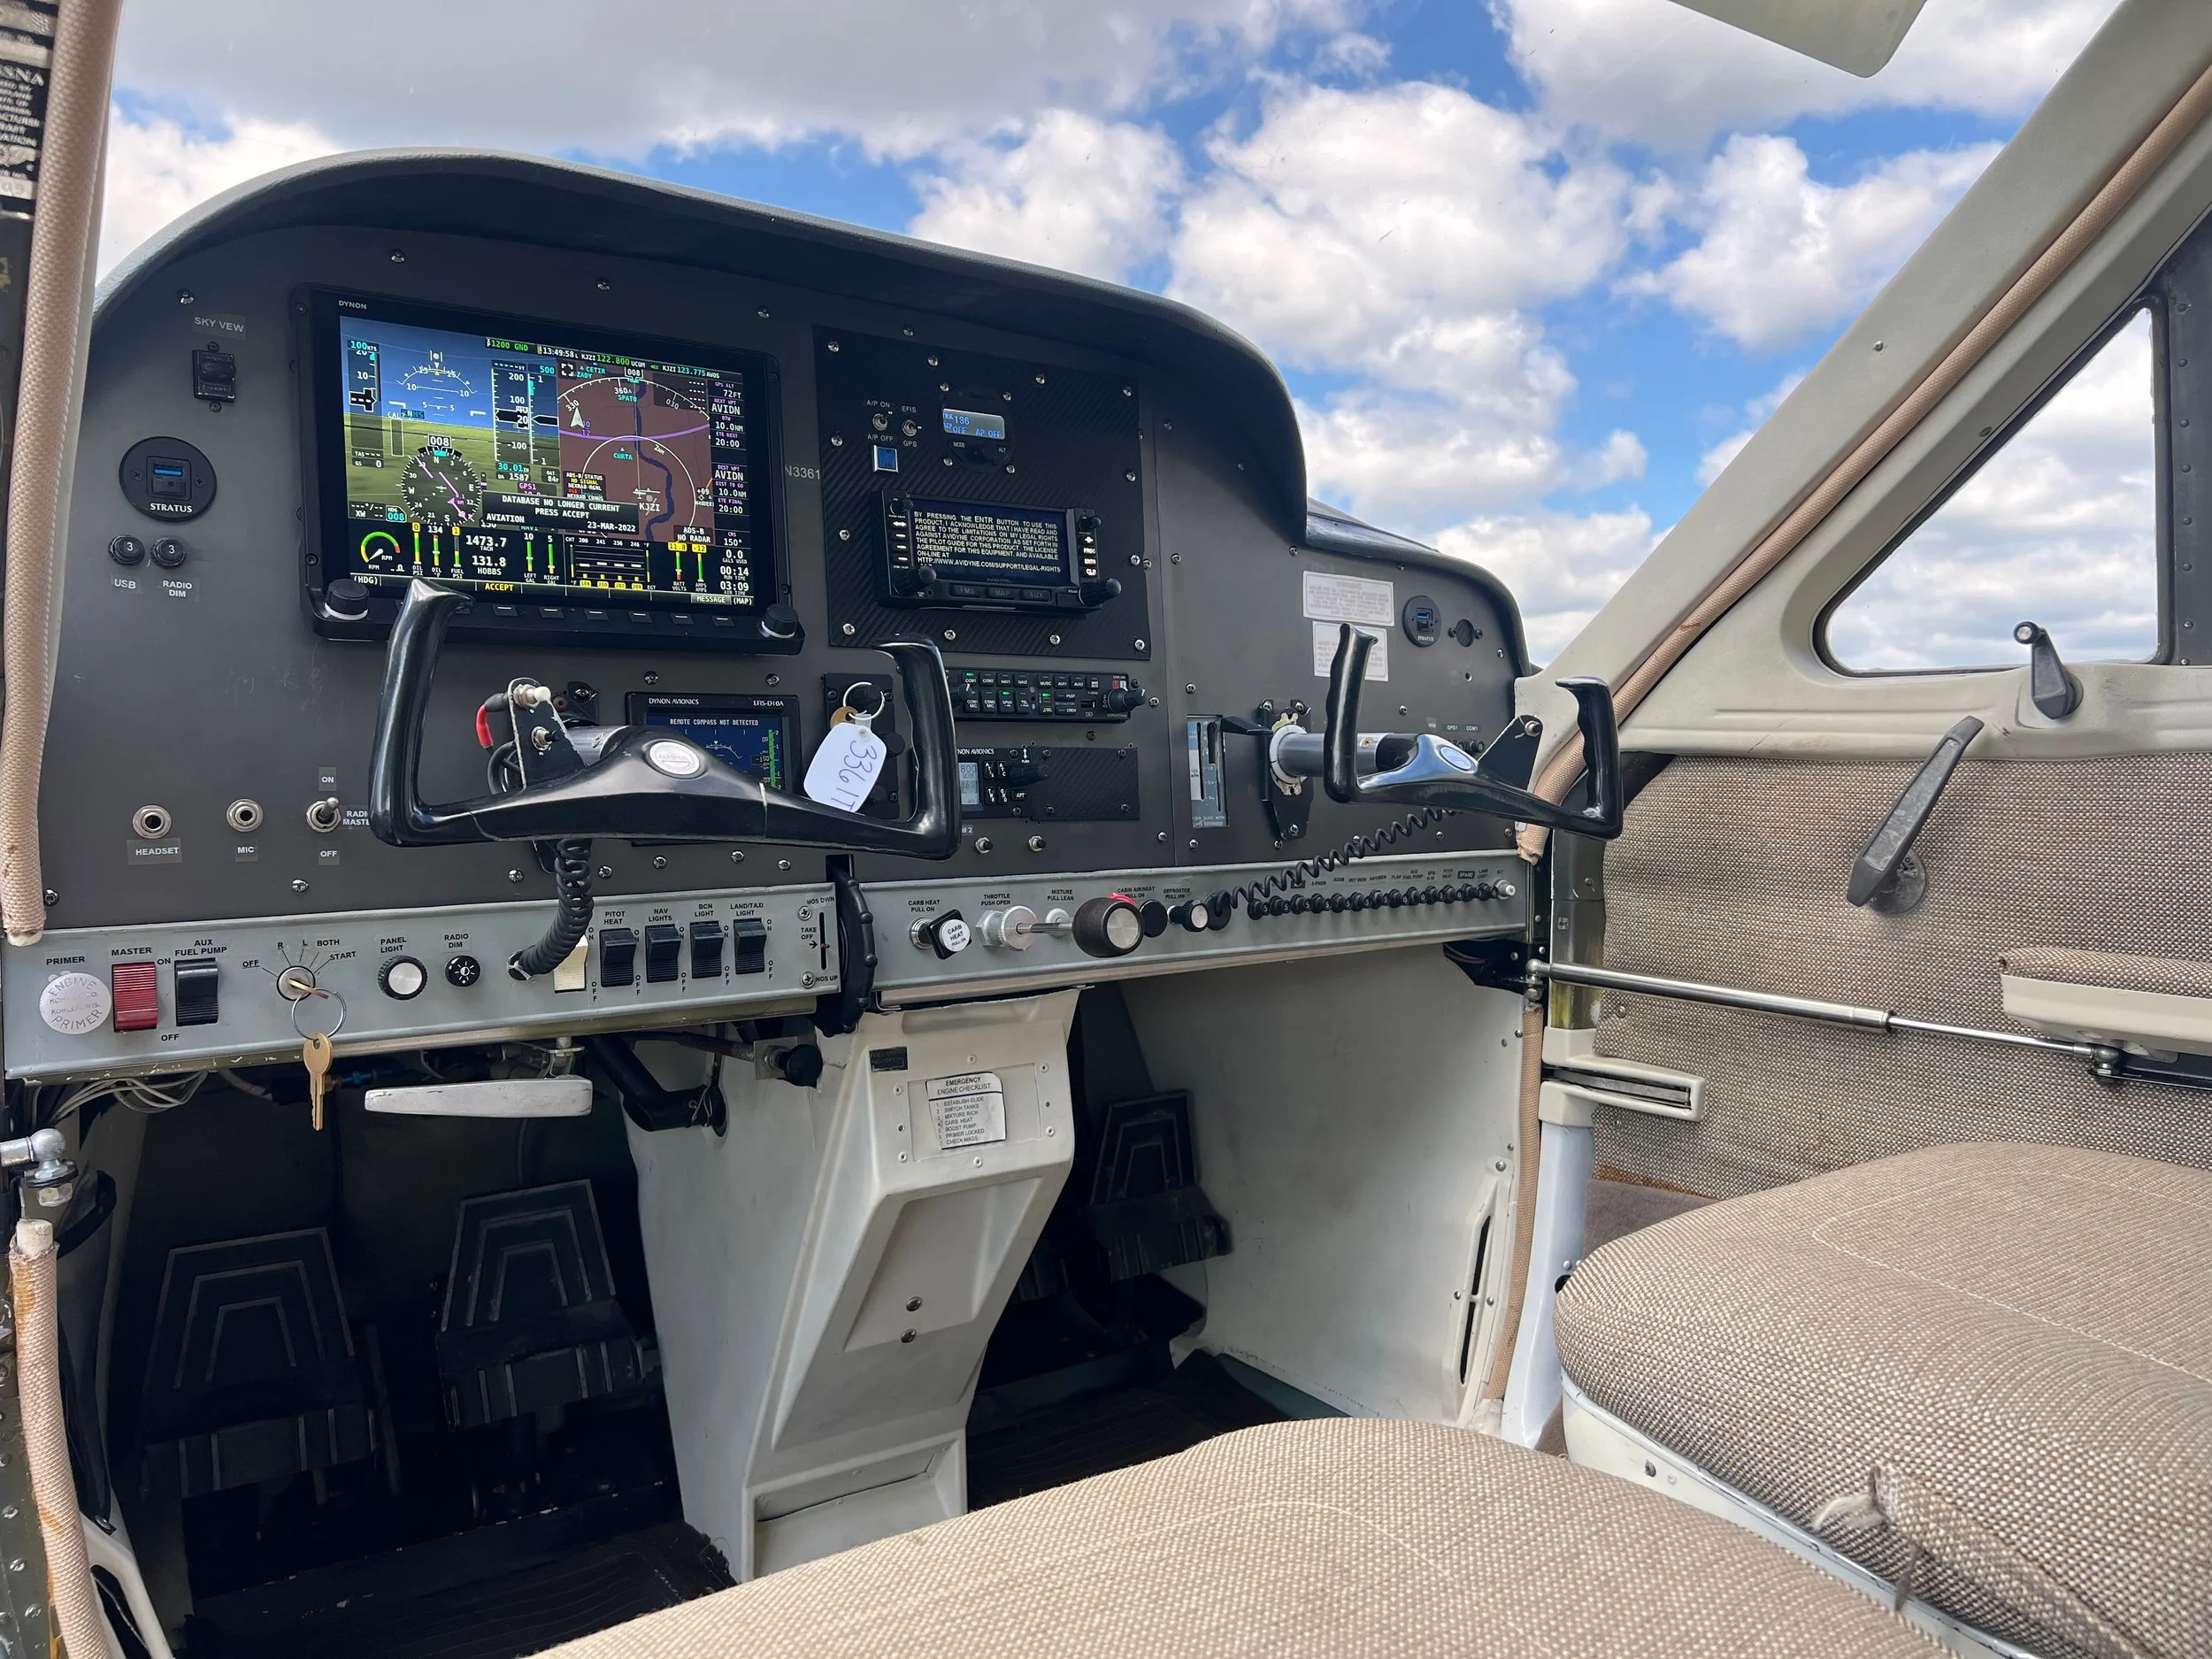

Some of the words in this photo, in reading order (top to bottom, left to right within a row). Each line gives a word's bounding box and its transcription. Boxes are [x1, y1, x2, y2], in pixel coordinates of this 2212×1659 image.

[338, 300, 367, 310] DYNON
[194, 316, 216, 327] SKY
[219, 320, 244, 333] VEW
[491, 340, 510, 349] 1200
[597, 355, 630, 365] 122.800
[677, 366, 706, 376] 123.775
[711, 403, 741, 415] AVIDN
[430, 435, 449, 446] 008
[715, 438, 740, 448] 20:00
[714, 470, 744, 481] AVIDN
[150, 503, 193, 513] STRATUS
[502, 495, 540, 505] DATABASE
[557, 499, 585, 510] LONGER
[588, 503, 620, 512] CURRENT
[639, 503, 661, 512] KJZI
[535, 508, 558, 517] PRESS
[563, 510, 589, 519] ACCEPT
[718, 504, 743, 514] 20:00
[487, 513, 525, 524] AVIATION
[974, 515, 994, 524] ENTR
[587, 521, 636, 532] 23-MAR-2022
[465, 534, 507, 548] 1473.7
[689, 534, 711, 543] RADAR
[127, 541, 134, 552] 3
[168, 544, 175, 555] 3
[472, 555, 507, 567] 131.8
[477, 566, 502, 576] HOBBS
[719, 565, 749, 577] 00:14
[114, 579, 136, 589] USB
[163, 580, 193, 590] RADIO
[353, 576, 379, 586] (HDG)
[485, 583, 514, 592] ACCEPT
[719, 581, 749, 592] 03:09
[168, 589, 187, 598] DIM
[733, 596, 752, 606] (MAP)
[947, 926, 963, 935] CARB
[380, 936, 407, 946] PANEL
[949, 931, 964, 941] HEAT
[111, 947, 152, 956] MASTER
[380, 944, 403, 953] LIGHT
[46, 956, 86, 965] PRIMER
[329, 951, 357, 960] START
[242, 959, 260, 969] OFF
[48, 976, 97, 997] ENGINE
[52, 1009, 104, 1030] PRIMER
[945, 1077, 981, 1087] EMERGENCY
[937, 1087, 959, 1095] ENGINE
[959, 1082, 991, 1093] CHECKLIST
